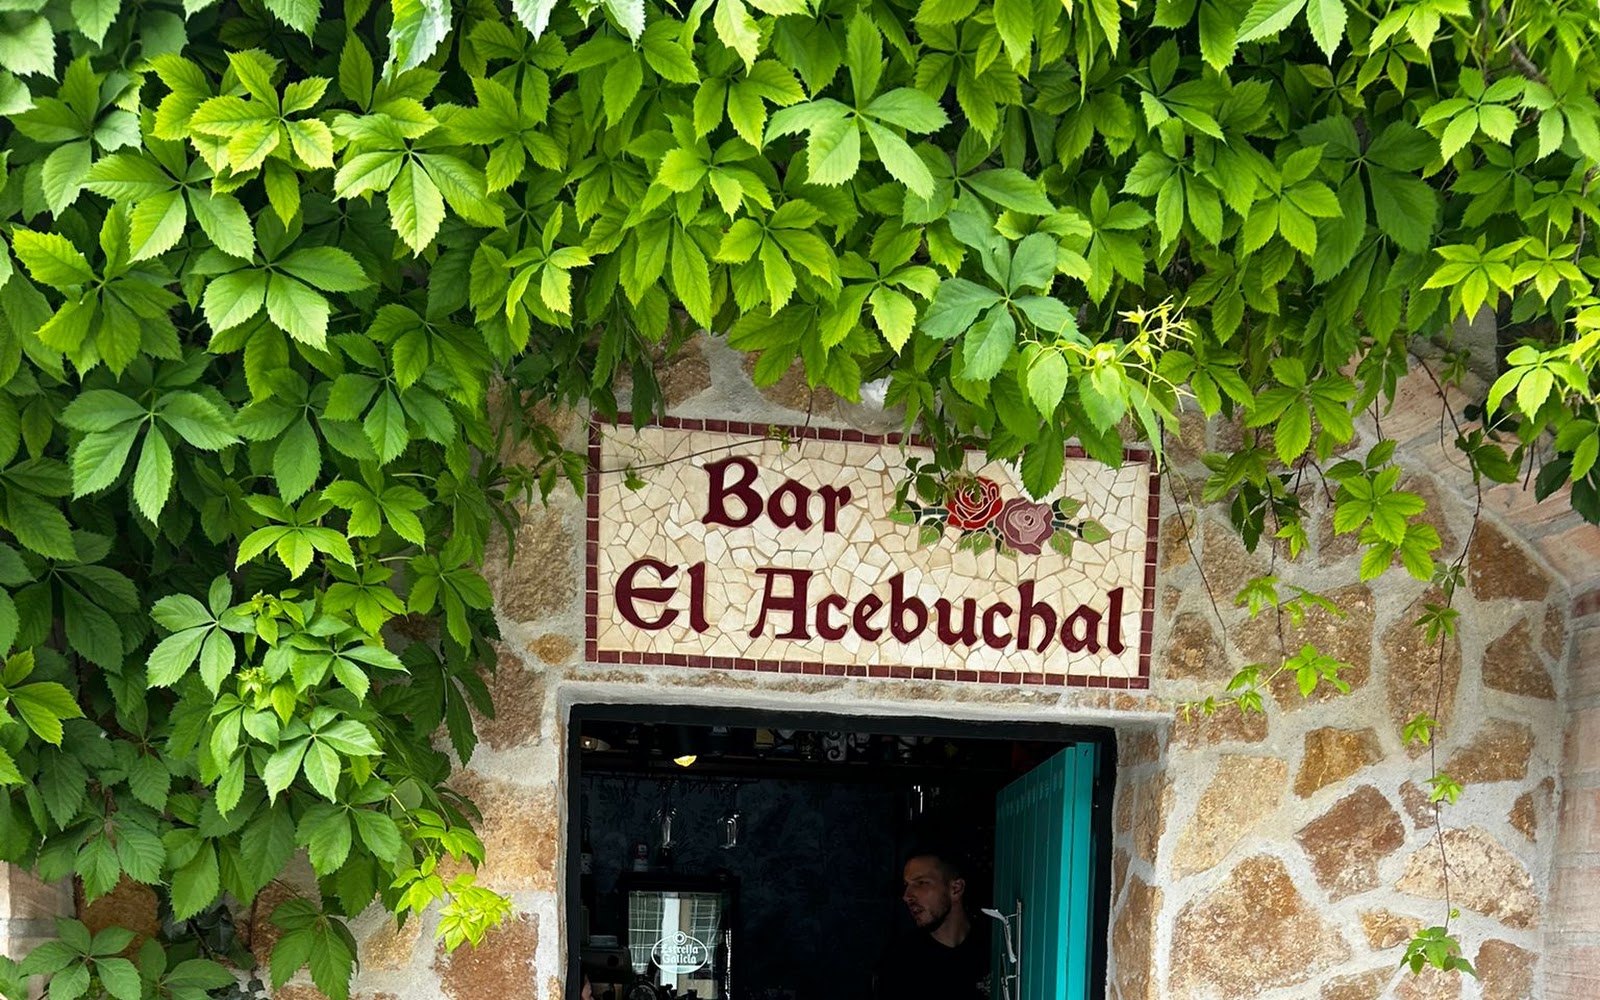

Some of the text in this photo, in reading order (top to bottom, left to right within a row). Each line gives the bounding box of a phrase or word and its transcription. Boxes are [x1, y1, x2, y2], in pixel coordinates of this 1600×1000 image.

[702, 456, 852, 533] Bar
[614, 557, 1125, 656] El Acebuchal
[661, 944, 699, 954] Estrella
[662, 954, 697, 964] Galicia
